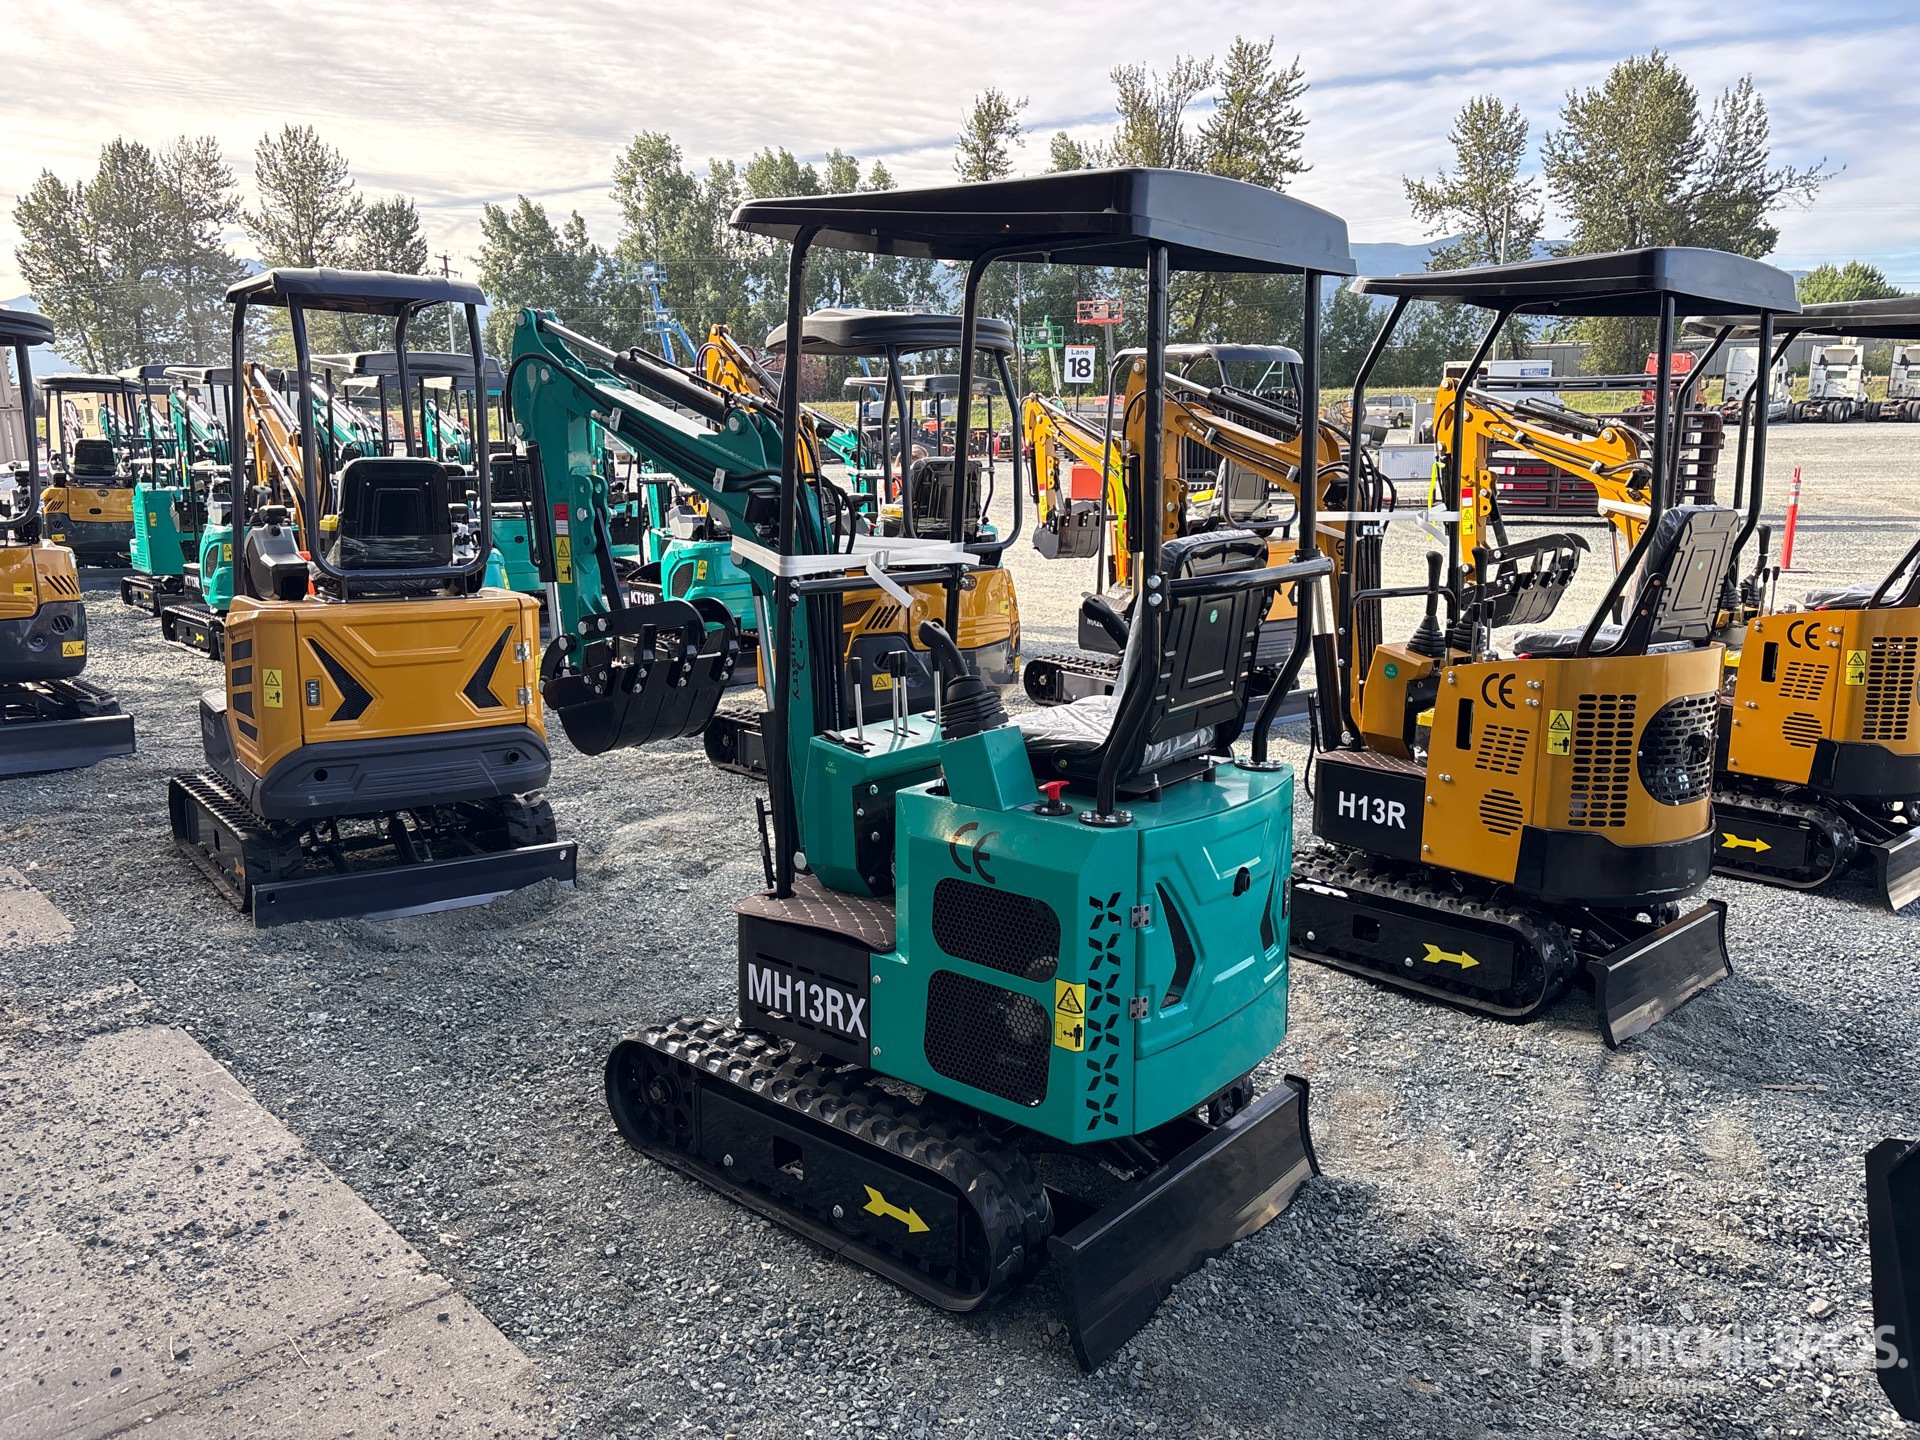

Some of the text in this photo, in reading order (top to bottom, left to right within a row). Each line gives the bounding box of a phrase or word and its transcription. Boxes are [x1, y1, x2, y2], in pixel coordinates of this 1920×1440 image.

[1068, 357, 1091, 378] 18
[630, 590, 655, 606] KT13R
[1787, 620, 1821, 651] CE
[1481, 672, 1516, 710] CE
[1338, 790, 1406, 830] H13R
[949, 821, 1002, 885] CE
[748, 962, 867, 1039] MH13RX
